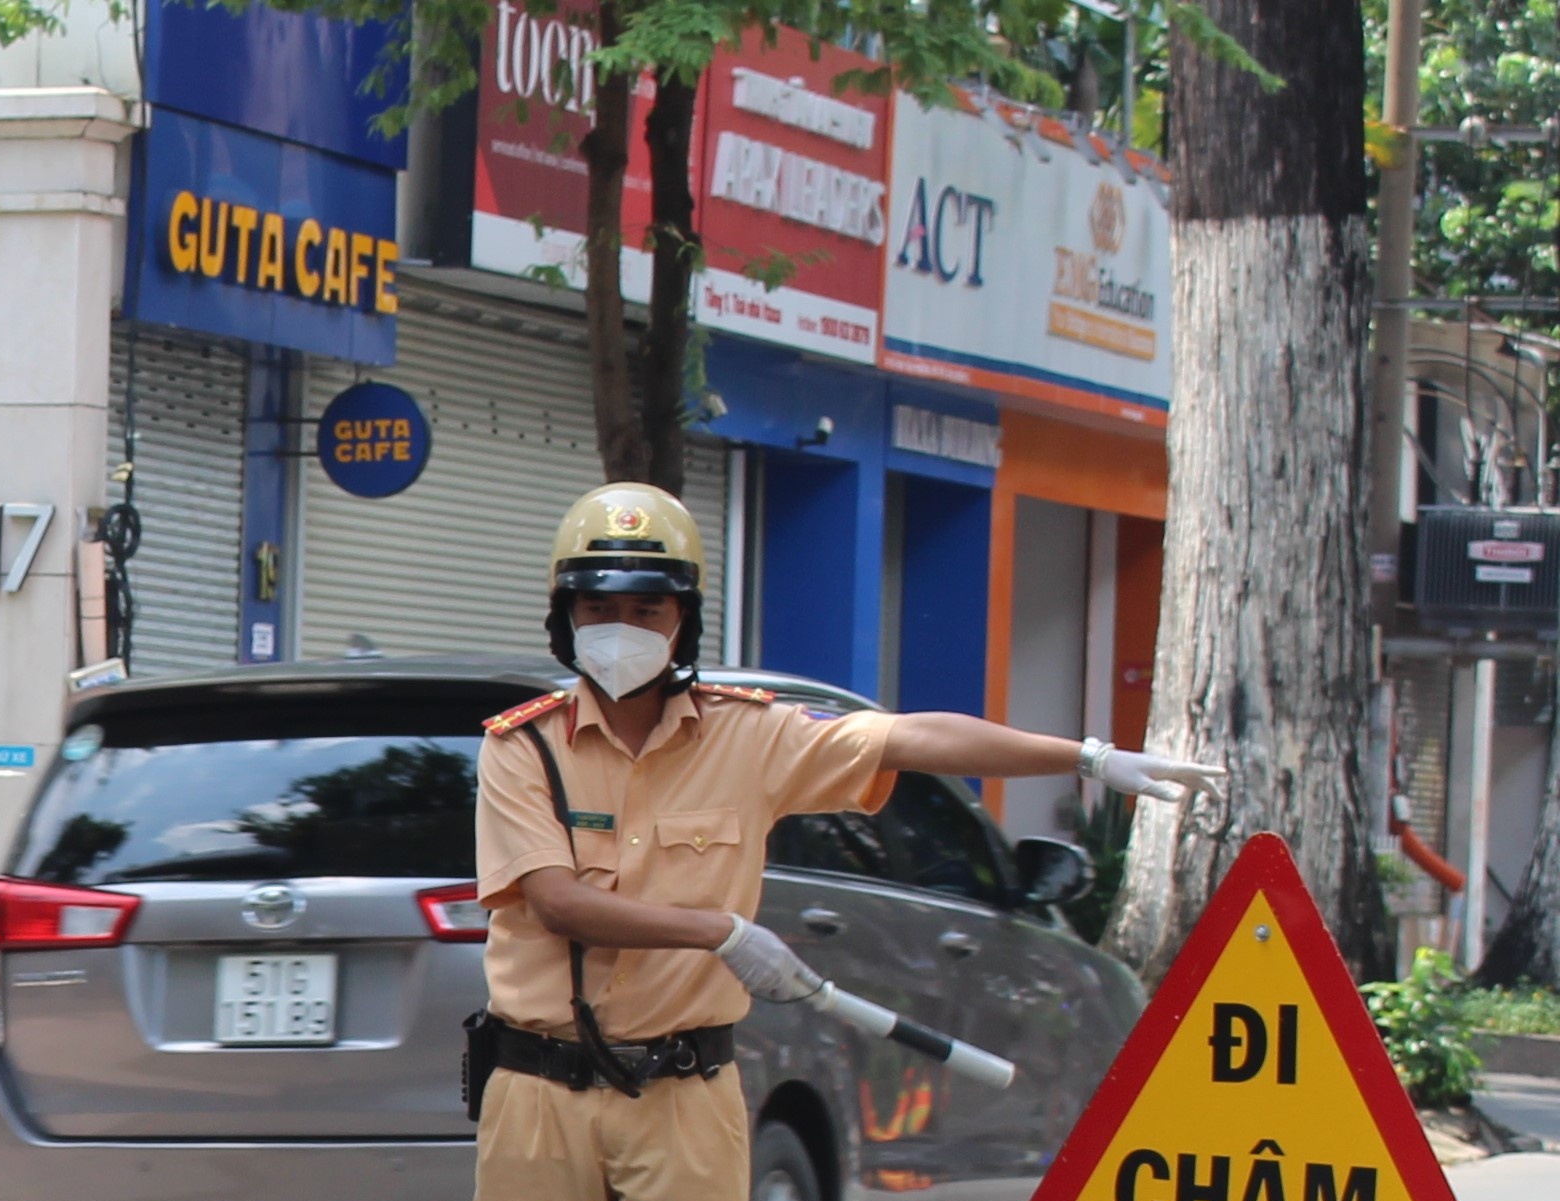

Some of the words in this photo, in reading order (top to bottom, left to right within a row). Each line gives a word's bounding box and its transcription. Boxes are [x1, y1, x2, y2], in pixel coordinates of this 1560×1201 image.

[169, 190, 284, 291] GUTA
[295, 217, 400, 314] CAFE
[896, 176, 996, 289] ACT
[334, 419, 411, 440] GUTA
[334, 441, 411, 462] CAFE
[1208, 1002, 1299, 1085] ĐI
